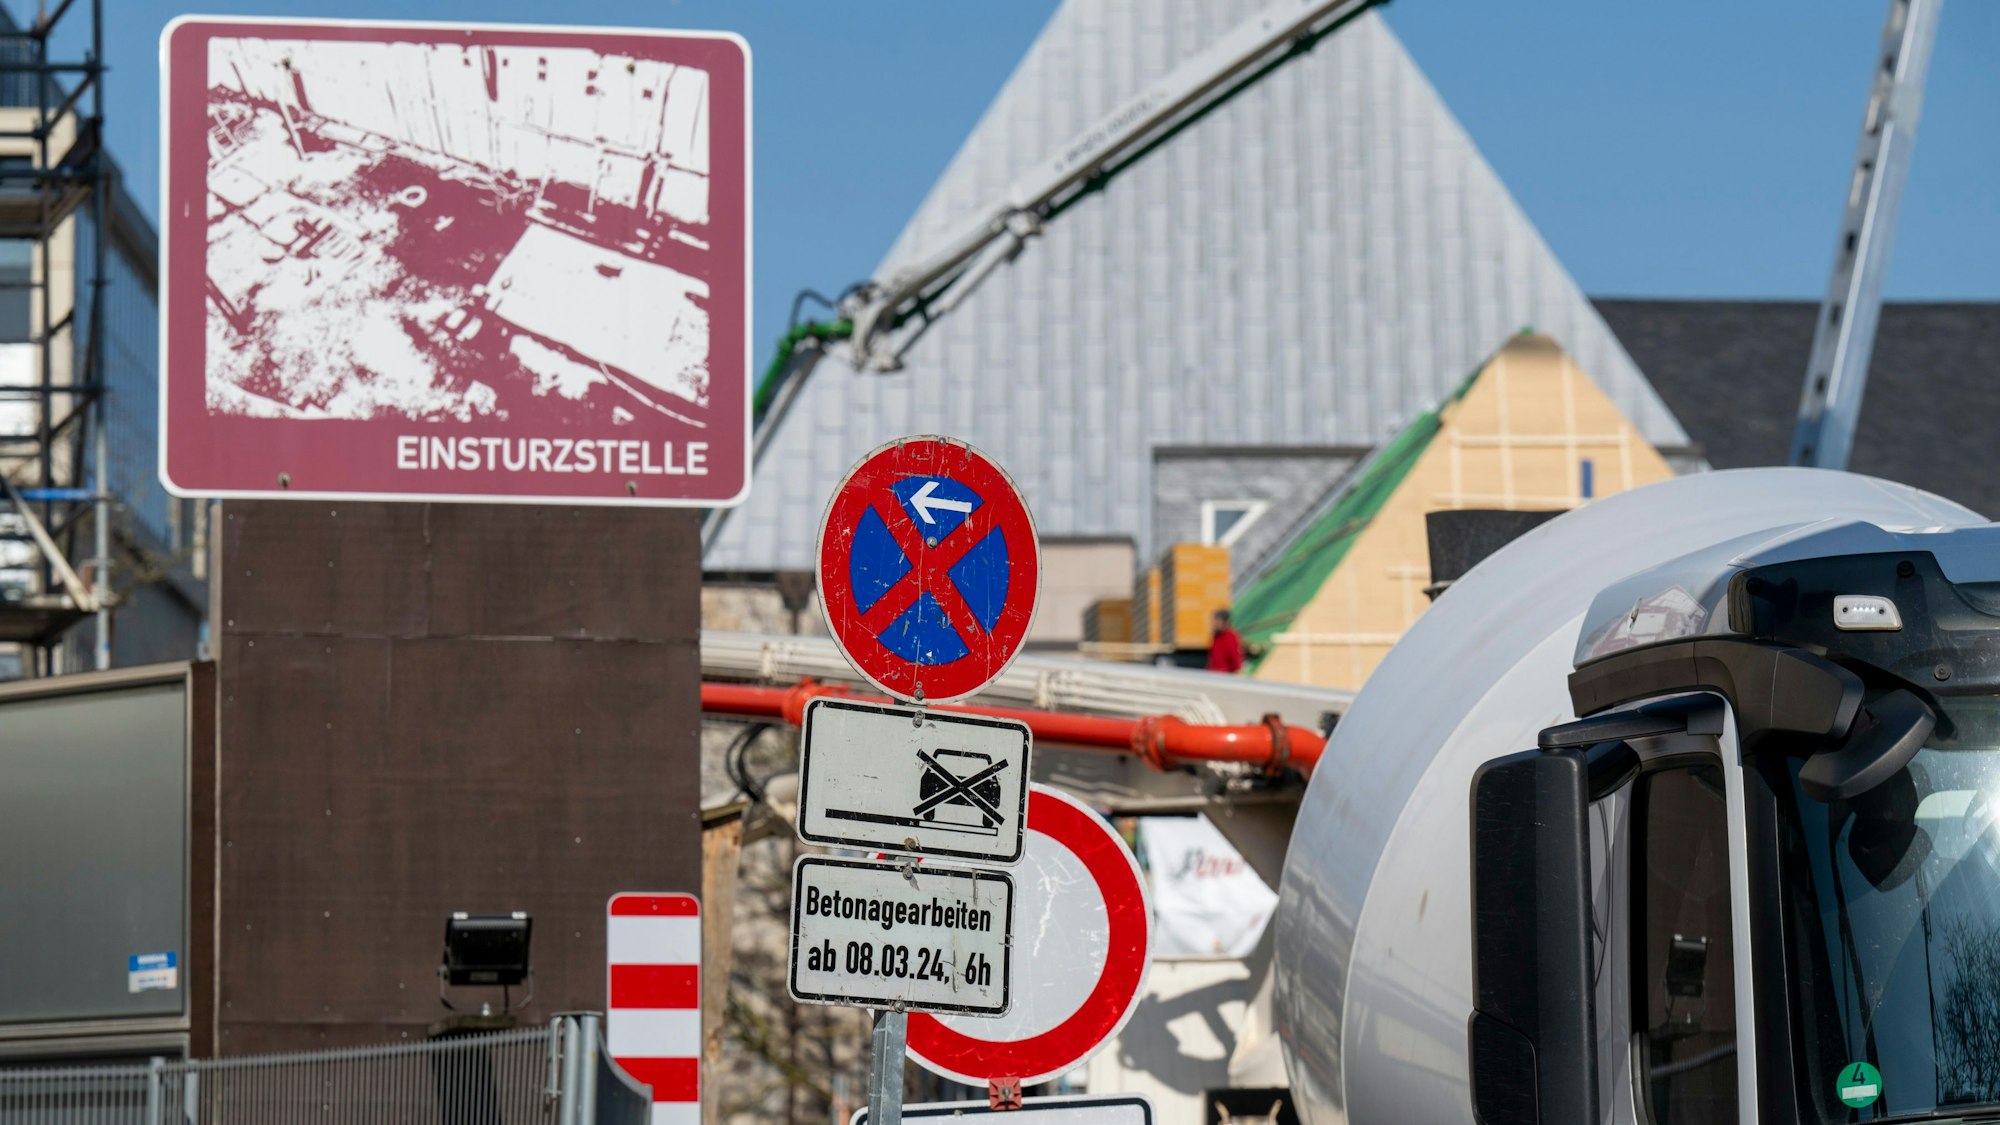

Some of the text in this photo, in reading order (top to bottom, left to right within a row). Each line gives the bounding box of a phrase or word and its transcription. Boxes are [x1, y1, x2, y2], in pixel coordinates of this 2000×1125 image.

[397, 436, 709, 475] EINSTURZSTELLE
[806, 885, 991, 932] Betonagearbeiten
[808, 939, 991, 986] ab 08.03.24, 6h
[1852, 1063, 1866, 1084] 4
